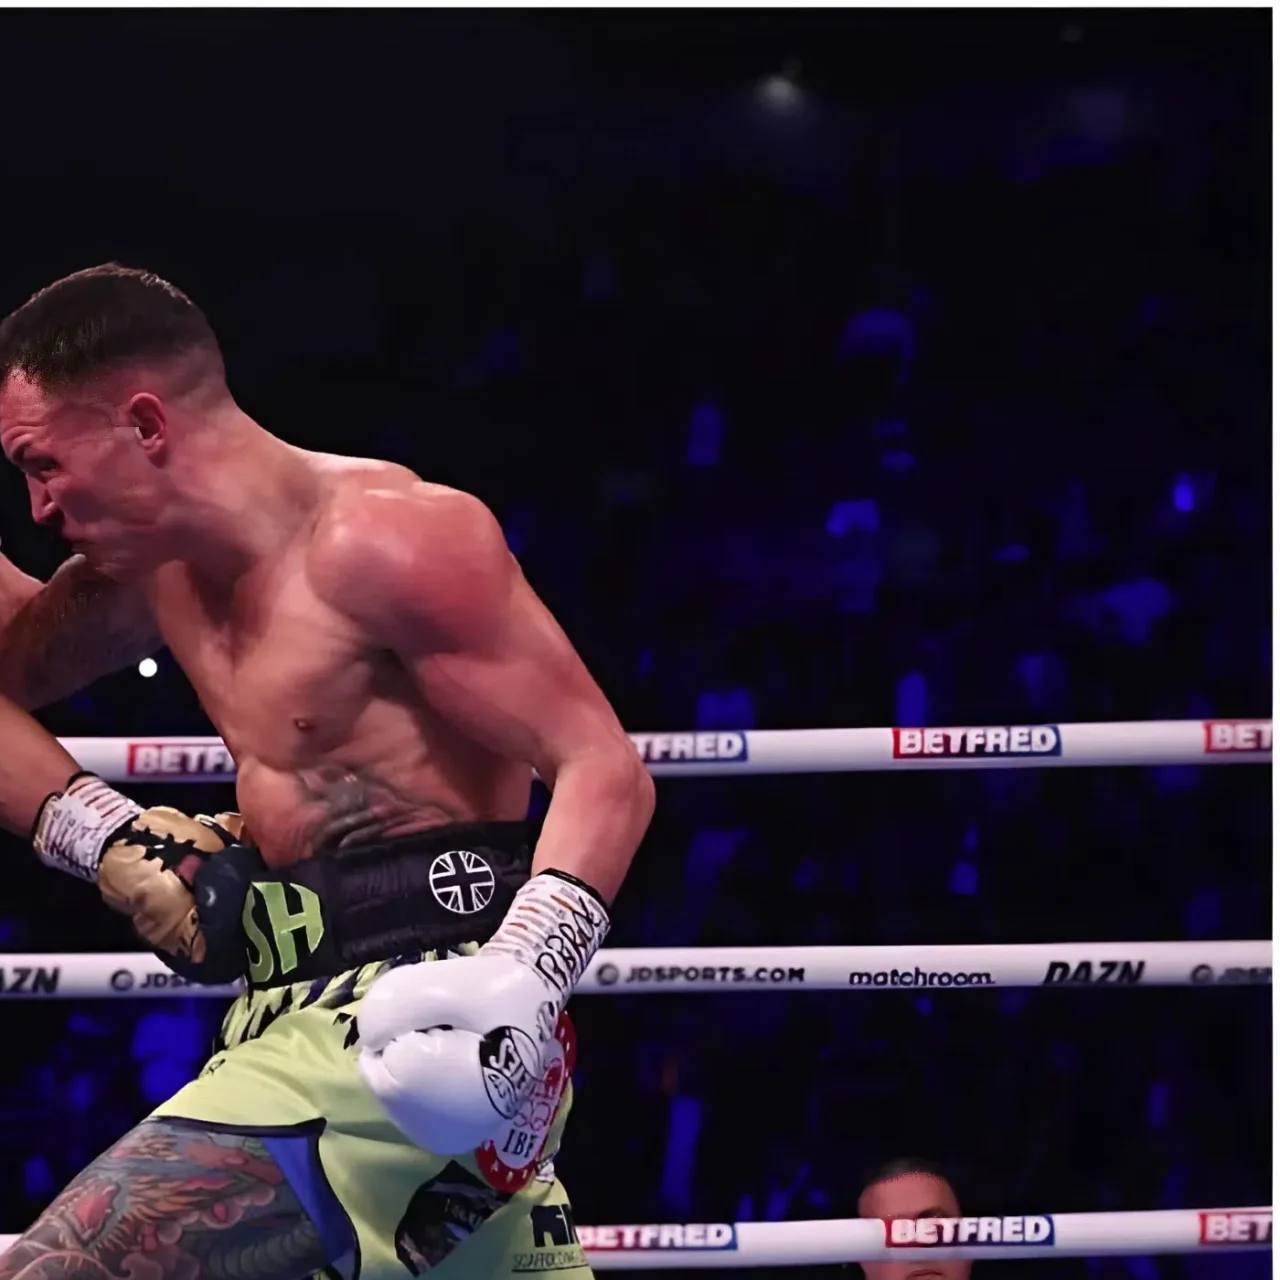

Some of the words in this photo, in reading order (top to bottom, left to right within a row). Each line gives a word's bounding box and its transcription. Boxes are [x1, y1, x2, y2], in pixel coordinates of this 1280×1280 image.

[899, 721, 1058, 755] BETFRED
[1043, 961, 1146, 986] DAZN
[890, 1215, 1051, 1243] BETFRED
